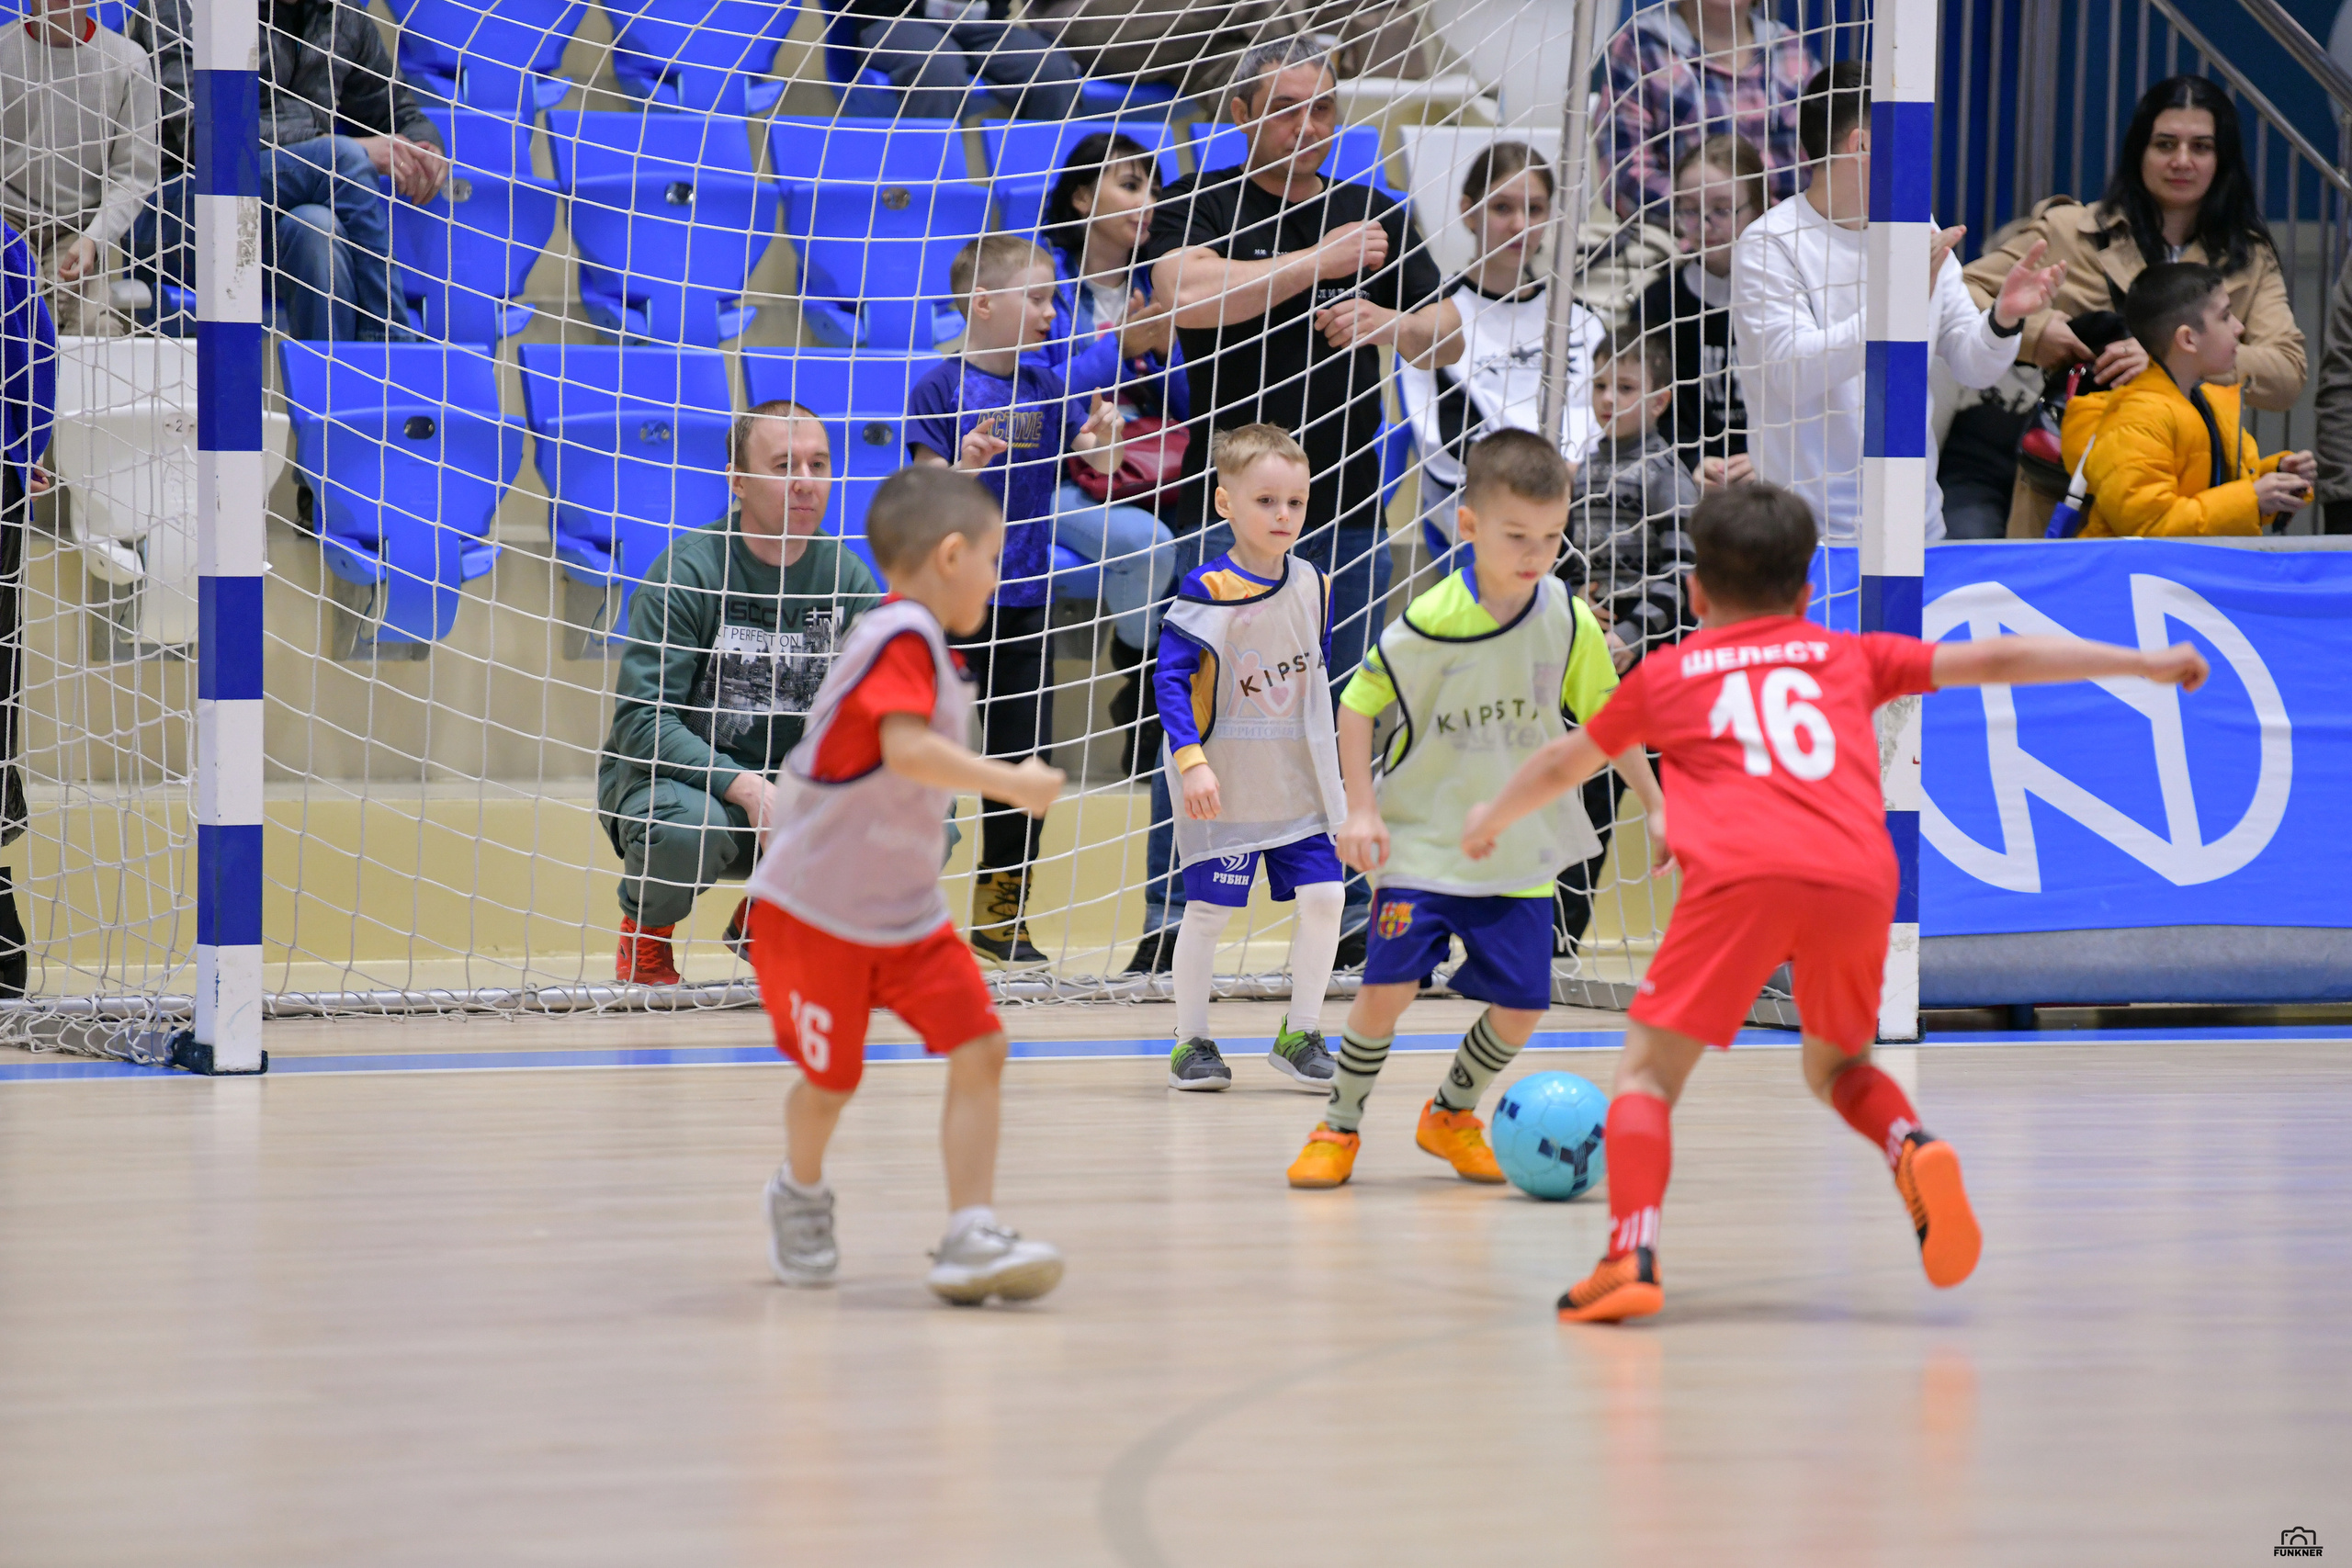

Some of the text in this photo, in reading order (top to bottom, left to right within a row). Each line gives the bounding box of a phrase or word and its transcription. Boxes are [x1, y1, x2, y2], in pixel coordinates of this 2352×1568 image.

[175, 419, 183, 433] 2
[1239, 651, 1327, 697] KIPSA
[1708, 667, 1837, 782] 16
[1213, 872, 1250, 886] РУБИН
